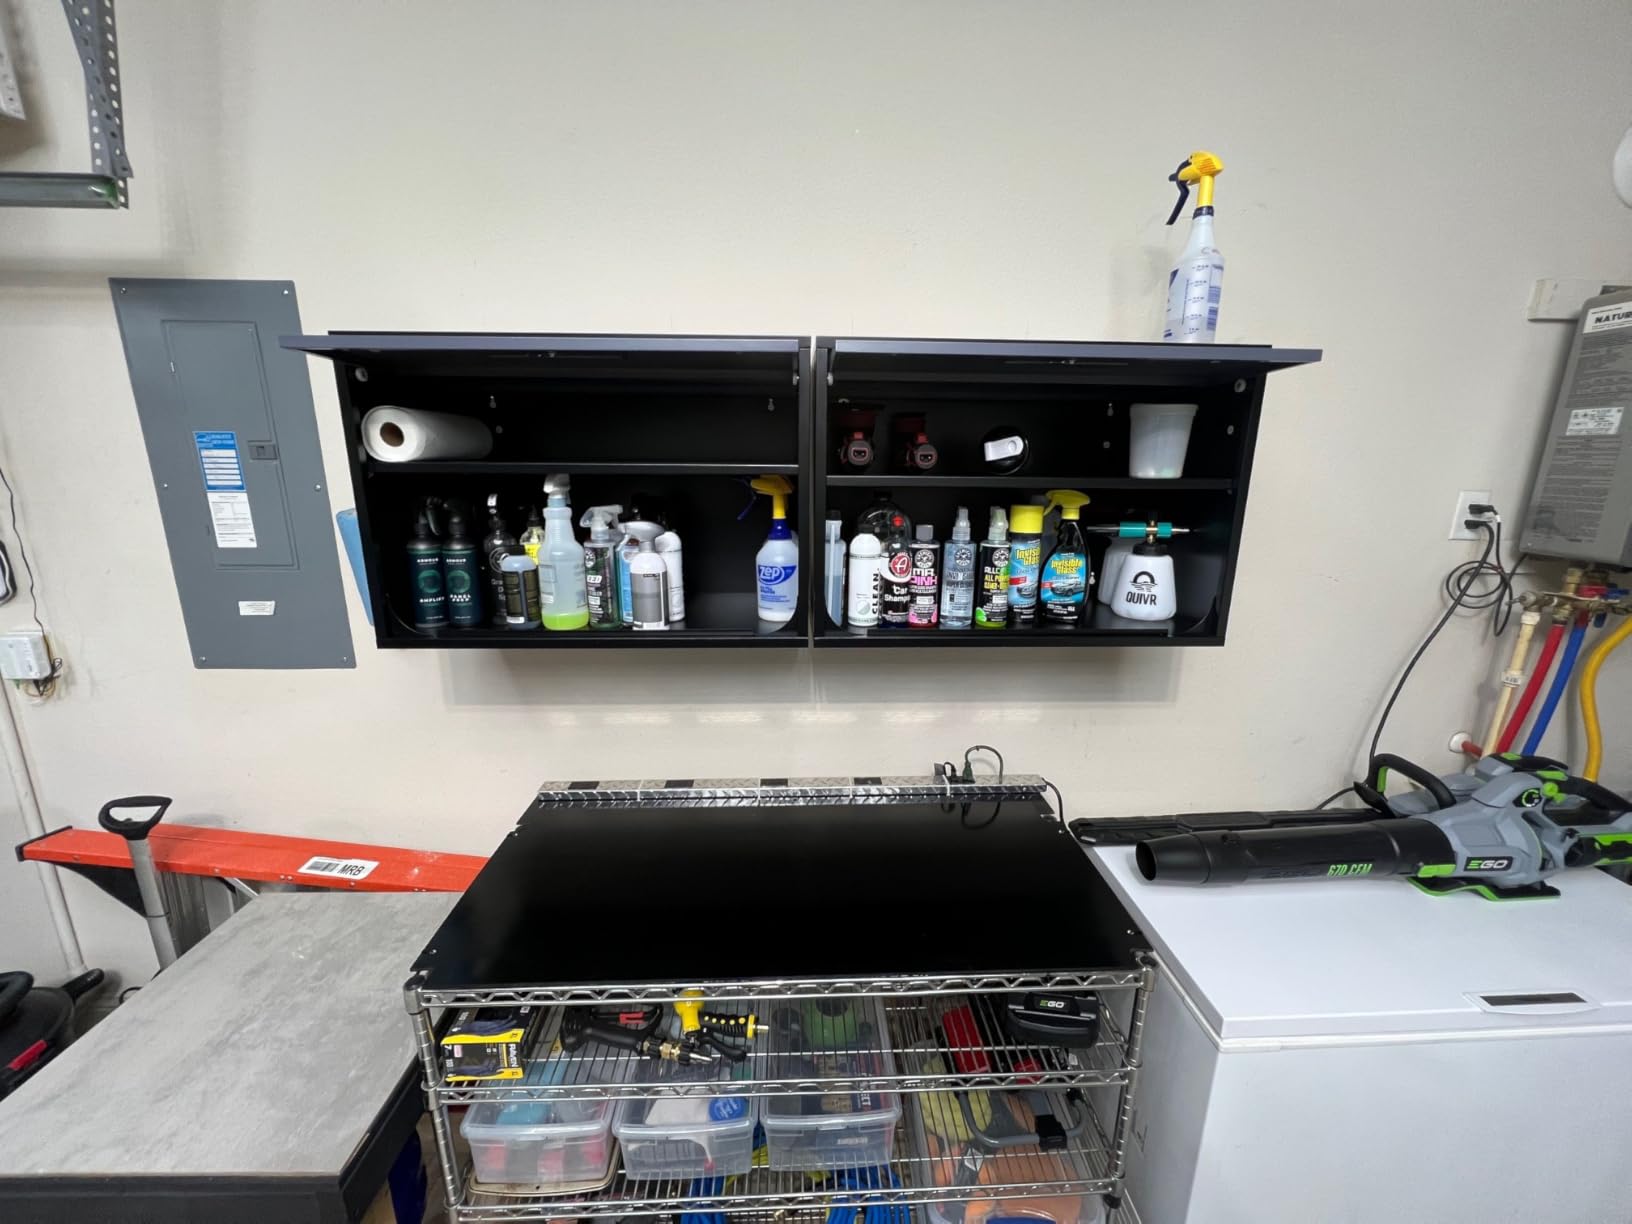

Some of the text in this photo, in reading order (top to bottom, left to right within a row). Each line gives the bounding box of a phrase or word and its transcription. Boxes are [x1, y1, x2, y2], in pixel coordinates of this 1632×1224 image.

[1126, 591, 1157, 606] QUIVR
[337, 863, 365, 876] MRB
[1327, 864, 1347, 877] 670
[1349, 863, 1373, 875] CFM
[1466, 859, 1508, 870] EGO
[1040, 999, 1065, 1008] EGO
[508, 1043, 519, 1067] RAVEN
